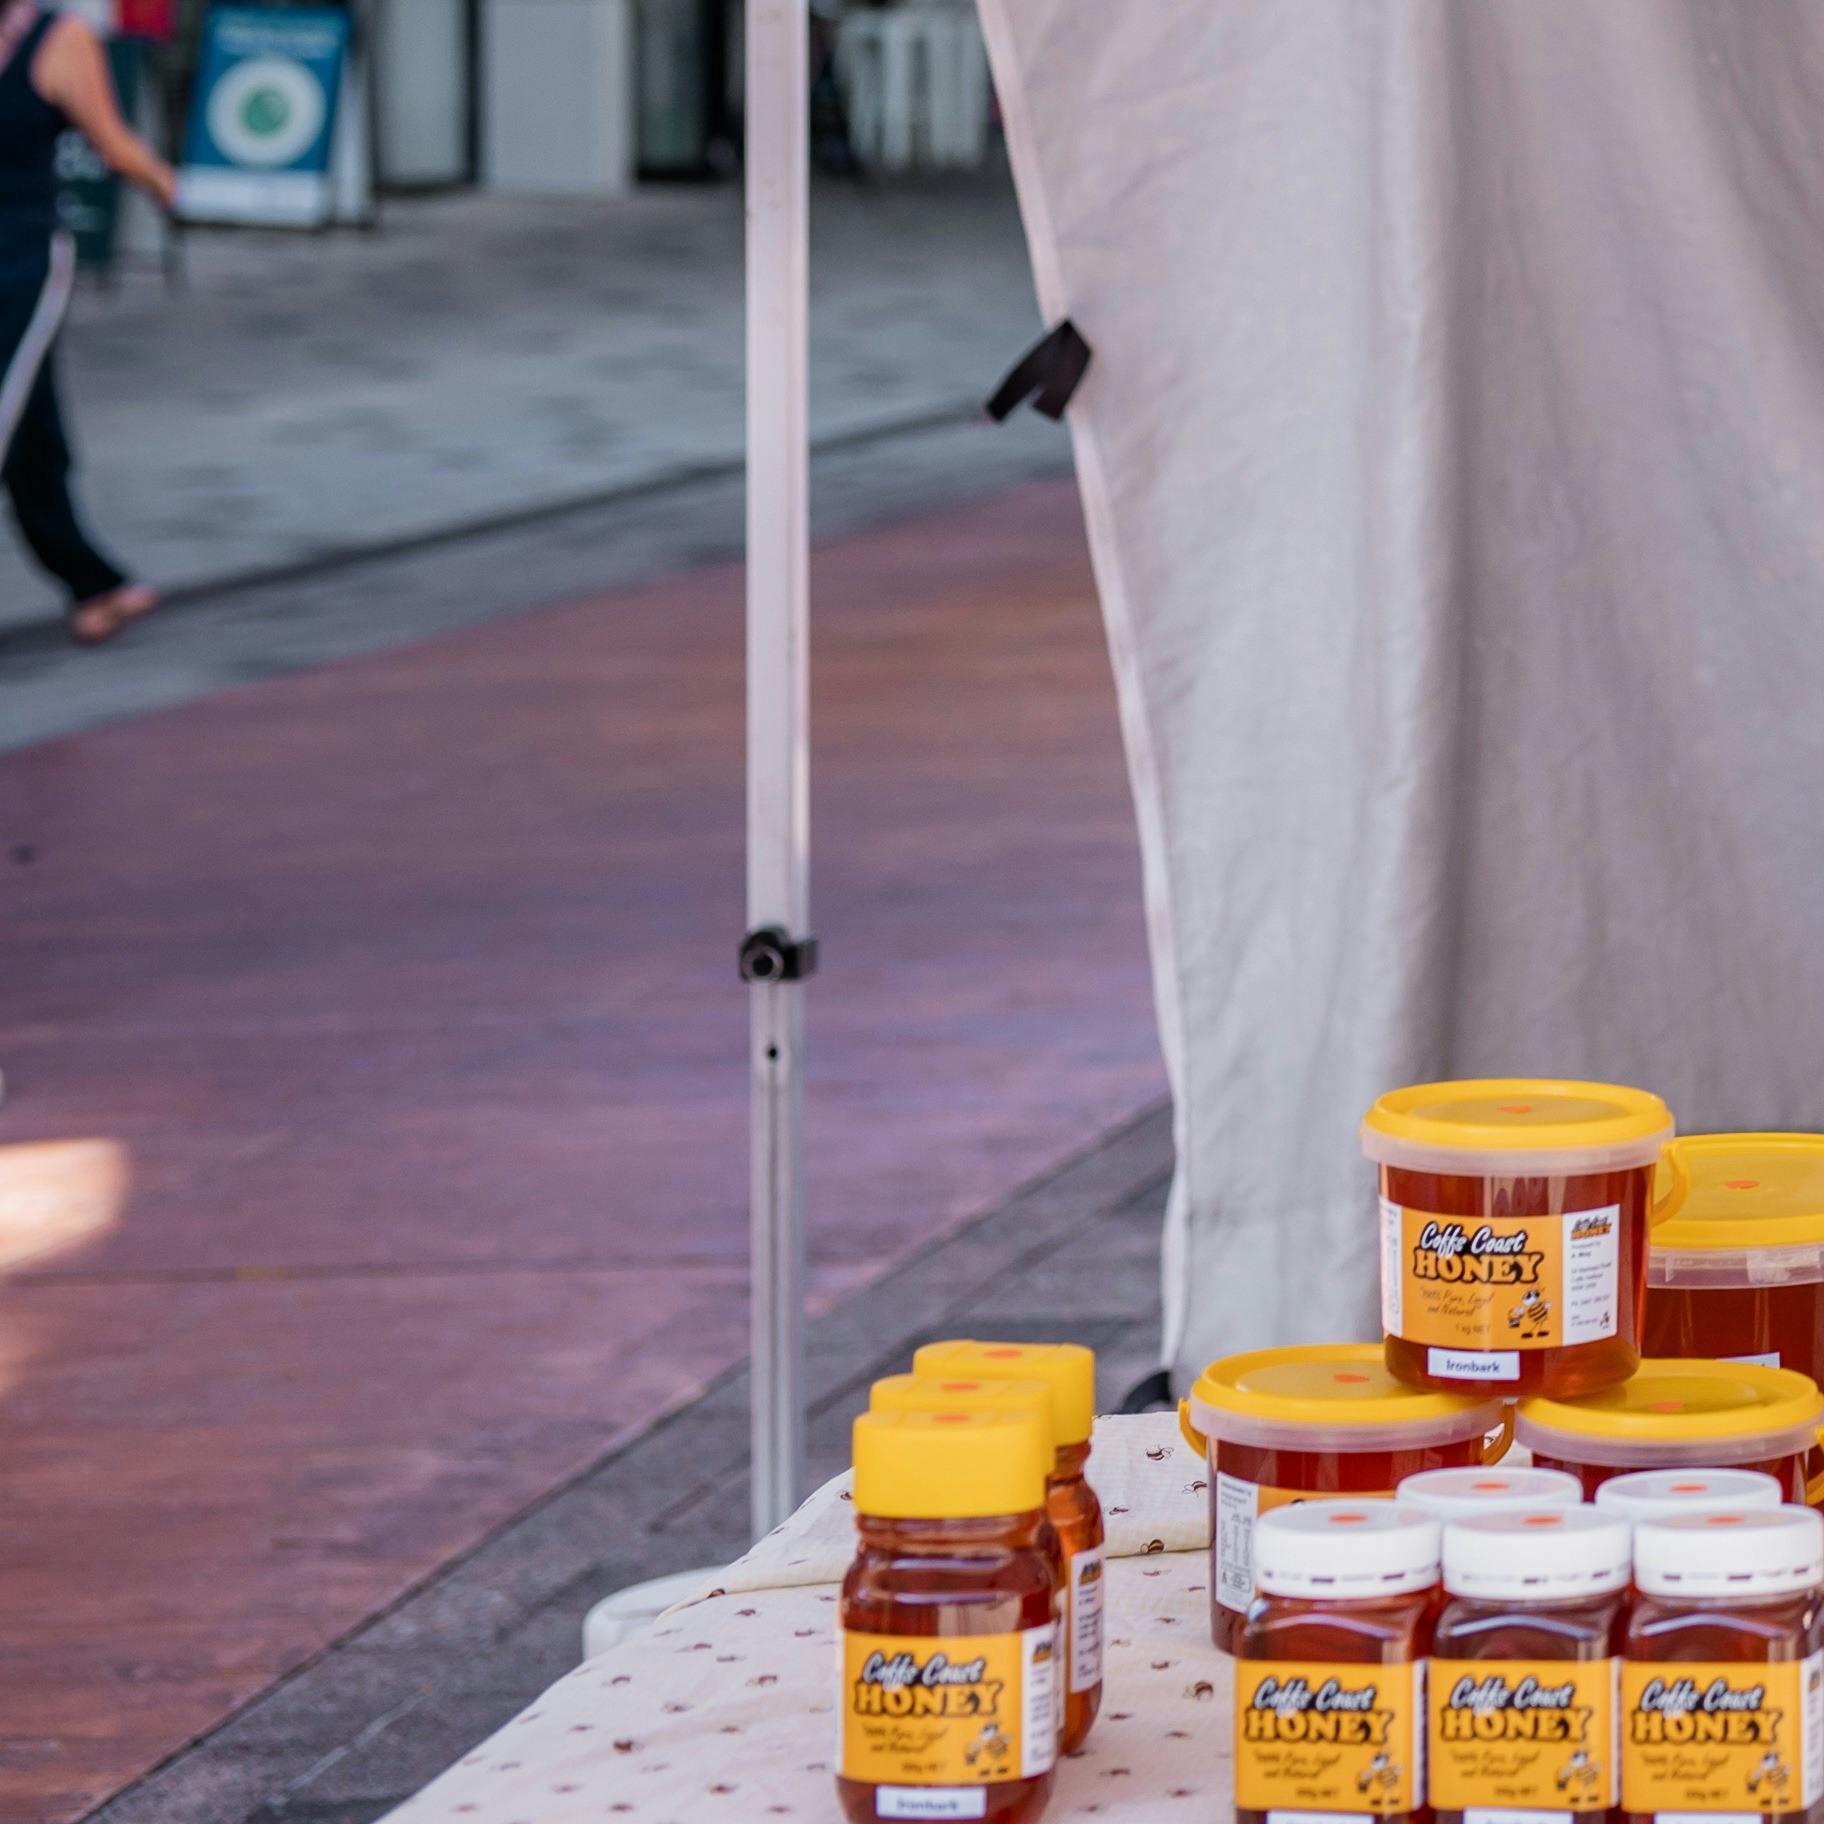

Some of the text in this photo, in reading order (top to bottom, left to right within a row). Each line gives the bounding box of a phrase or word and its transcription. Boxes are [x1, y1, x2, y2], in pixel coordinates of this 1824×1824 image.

[1421, 1221, 1527, 1259] Coffs Coast
[1413, 1248, 1544, 1284] HONEY
[1446, 1359, 1499, 1373] Ironbark
[854, 1680, 1003, 1718] HONEY
[1244, 1707, 1394, 1746] HONEY
[1441, 1706, 1593, 1743] HONEY
[1631, 1709, 1783, 1745] HONEY
